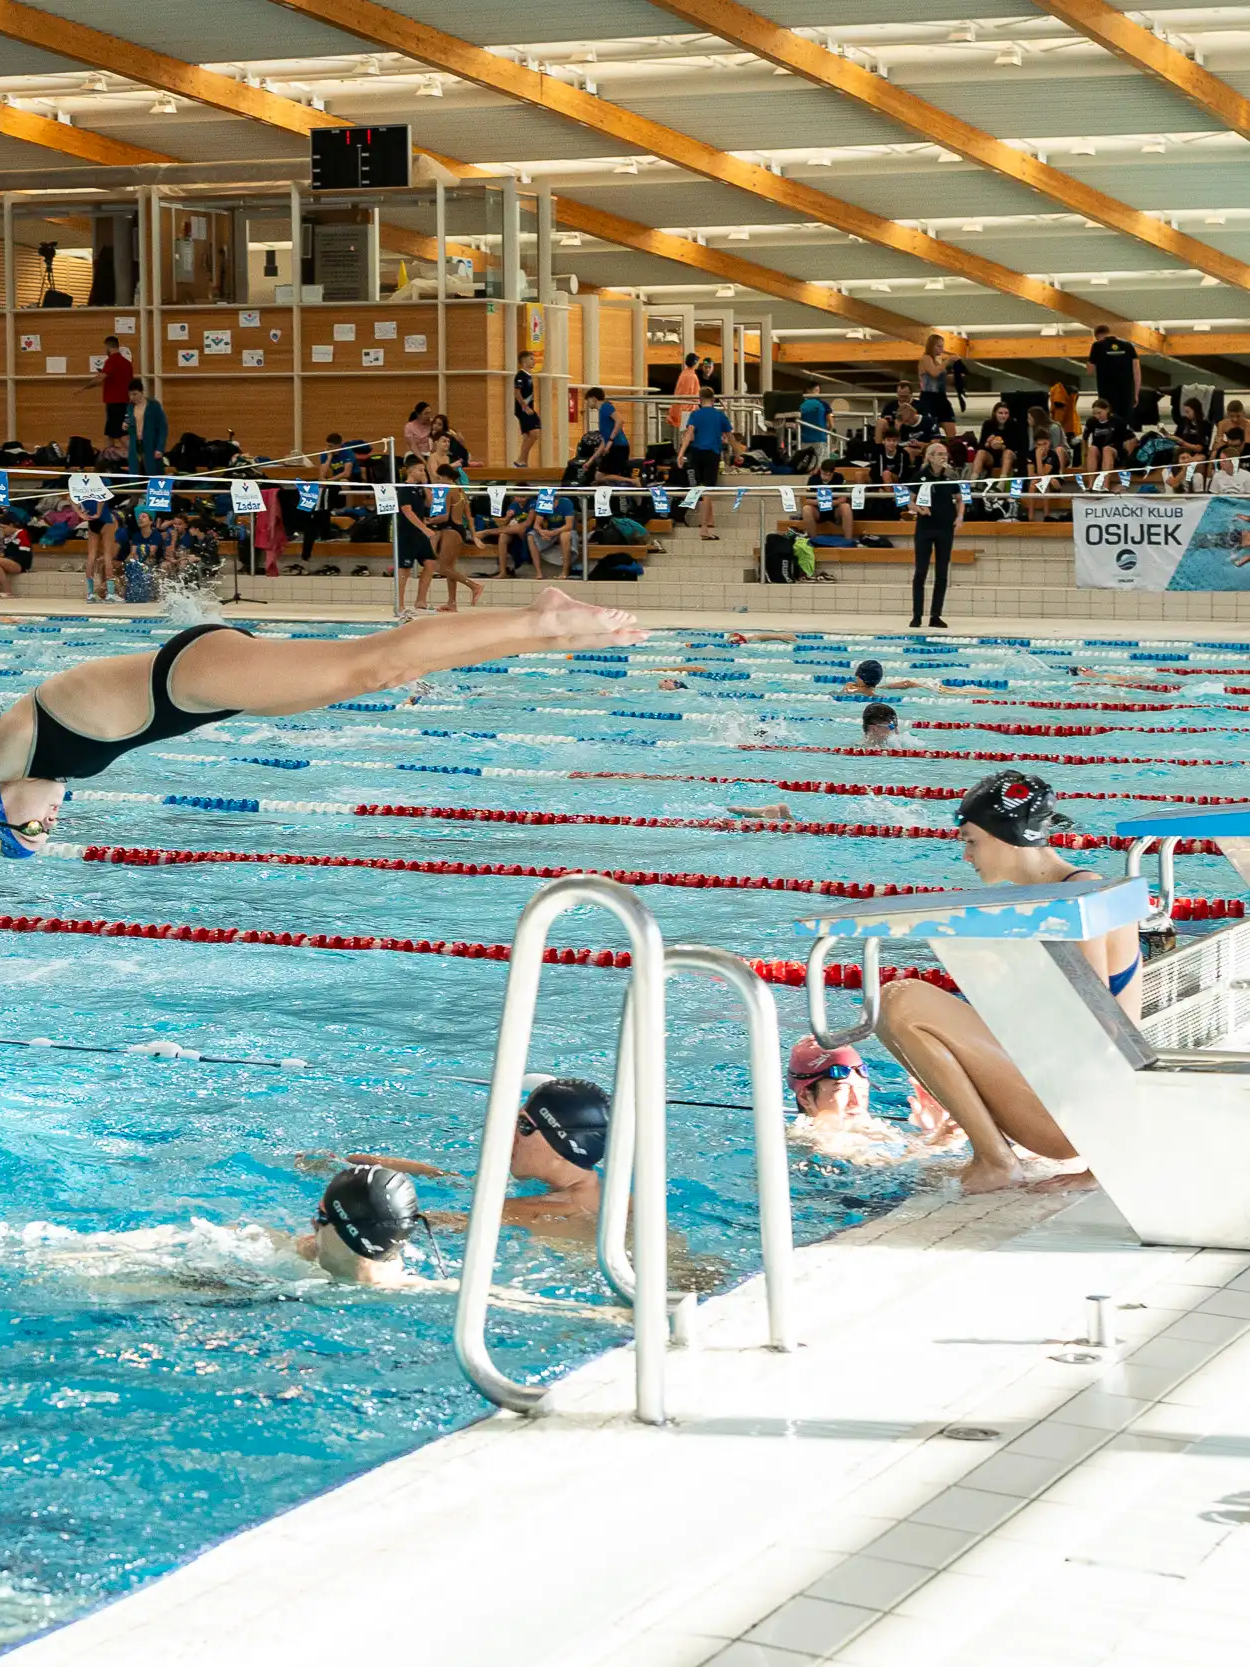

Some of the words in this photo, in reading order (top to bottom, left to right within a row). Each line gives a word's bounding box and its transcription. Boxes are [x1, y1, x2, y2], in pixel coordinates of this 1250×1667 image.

[236, 502, 261, 511] Zadar
[1085, 504, 1143, 519] PLIVAČKI
[1148, 507, 1184, 518] KLUB
[1085, 523, 1183, 546] OSIJEK
